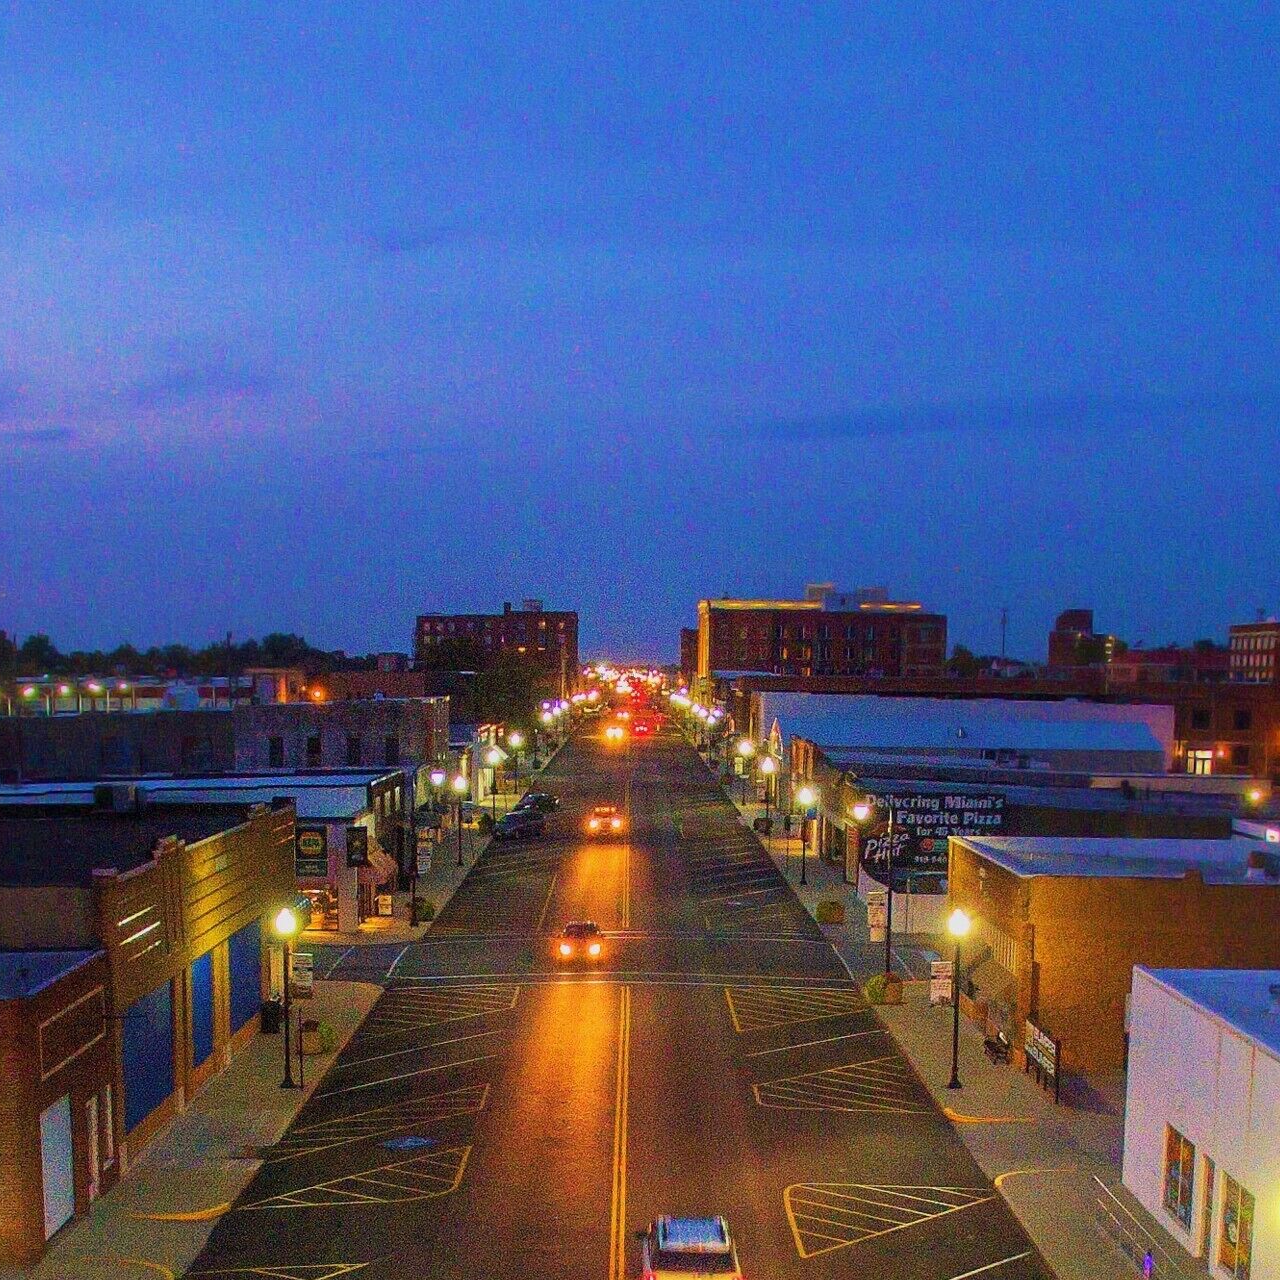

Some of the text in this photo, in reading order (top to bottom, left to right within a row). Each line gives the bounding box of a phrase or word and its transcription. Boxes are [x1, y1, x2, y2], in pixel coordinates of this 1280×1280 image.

[865, 794, 1004, 811] Delivering Miami's
[896, 810, 1002, 825] Favorite Pizza
